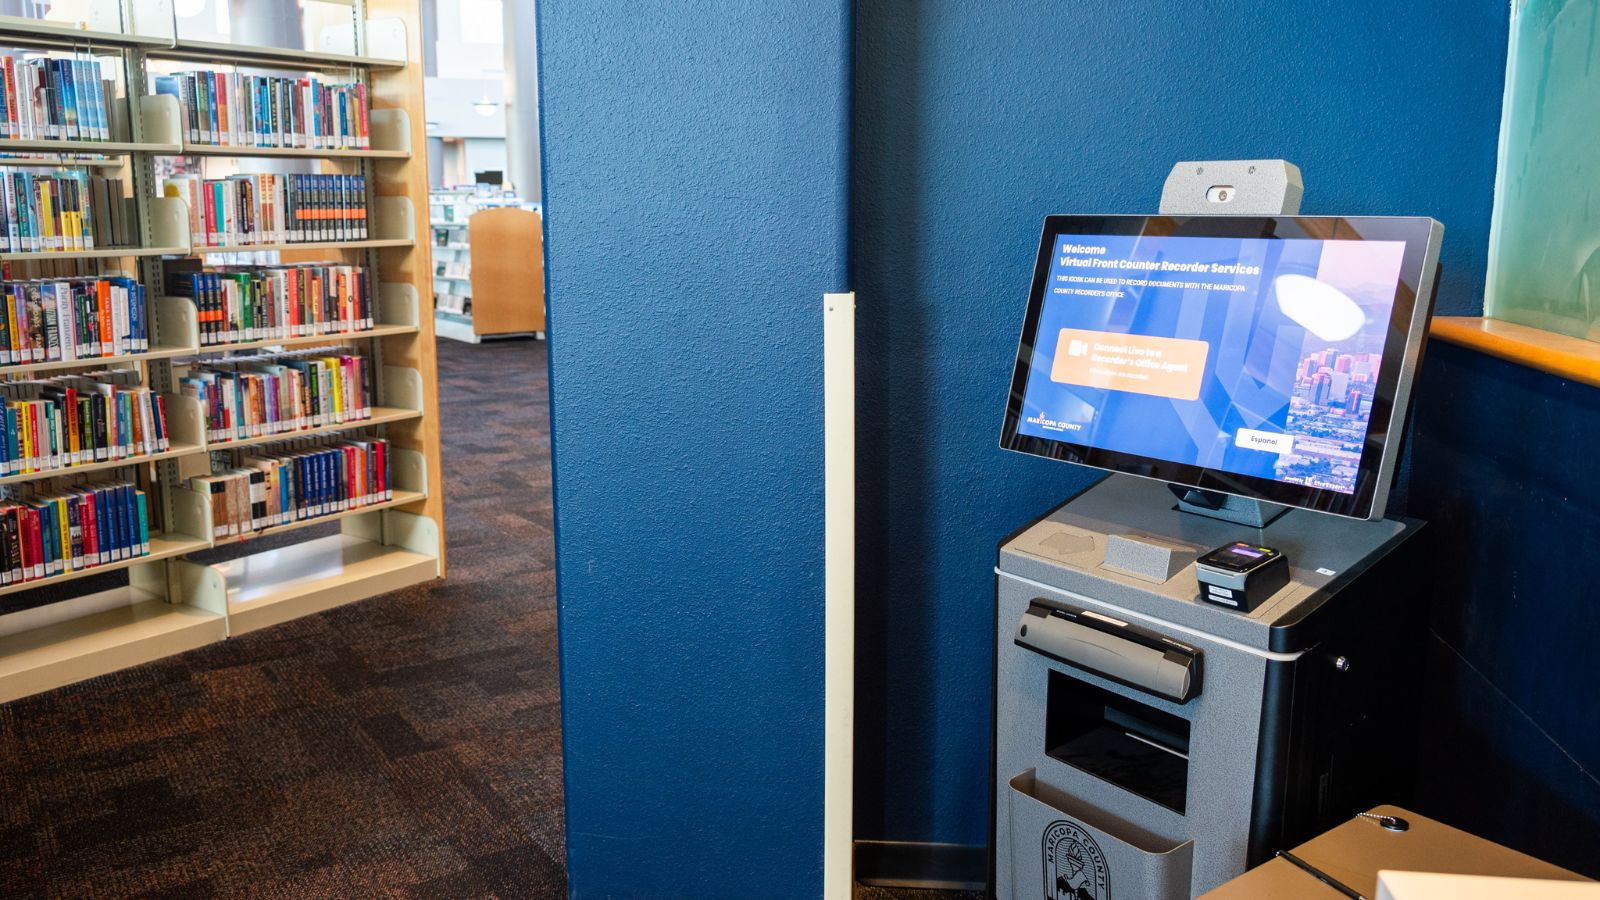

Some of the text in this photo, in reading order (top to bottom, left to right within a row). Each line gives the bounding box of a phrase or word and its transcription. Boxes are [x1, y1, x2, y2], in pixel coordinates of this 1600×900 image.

[1063, 244, 1106, 255] Welcome
[1060, 257, 1260, 274] Virtual Front Counter Recorder Services
[1149, 280, 1184, 288] DOCUMENTS
[1213, 283, 1246, 292] MARICOPA
[1094, 343, 1128, 354] Connect
[1128, 345, 1144, 355] Live
[1146, 347, 1155, 356] to
[1092, 354, 1188, 373] Recorder's Office Agent
[1027, 416, 1056, 426] MARICOPA
[1058, 422, 1081, 430] COUNTY
[1048, 828, 1104, 890] MARICOPA COUNTY
